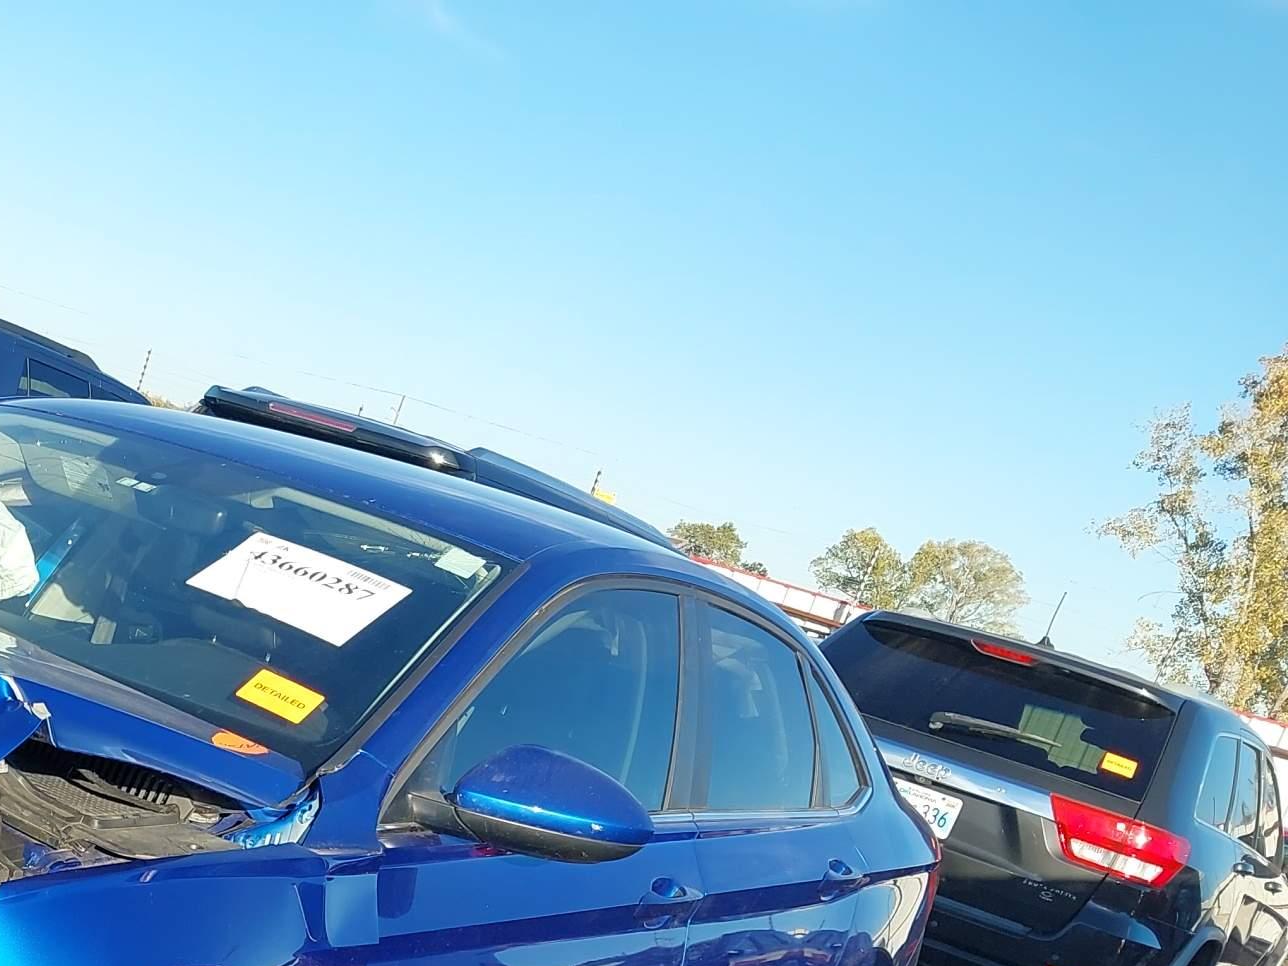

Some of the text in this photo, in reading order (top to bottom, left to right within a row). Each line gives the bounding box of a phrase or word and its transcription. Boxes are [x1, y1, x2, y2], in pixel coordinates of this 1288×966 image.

[249, 550, 376, 600] 43660287
[254, 682, 306, 710] DETAILED
[902, 752, 952, 781] Jeep
